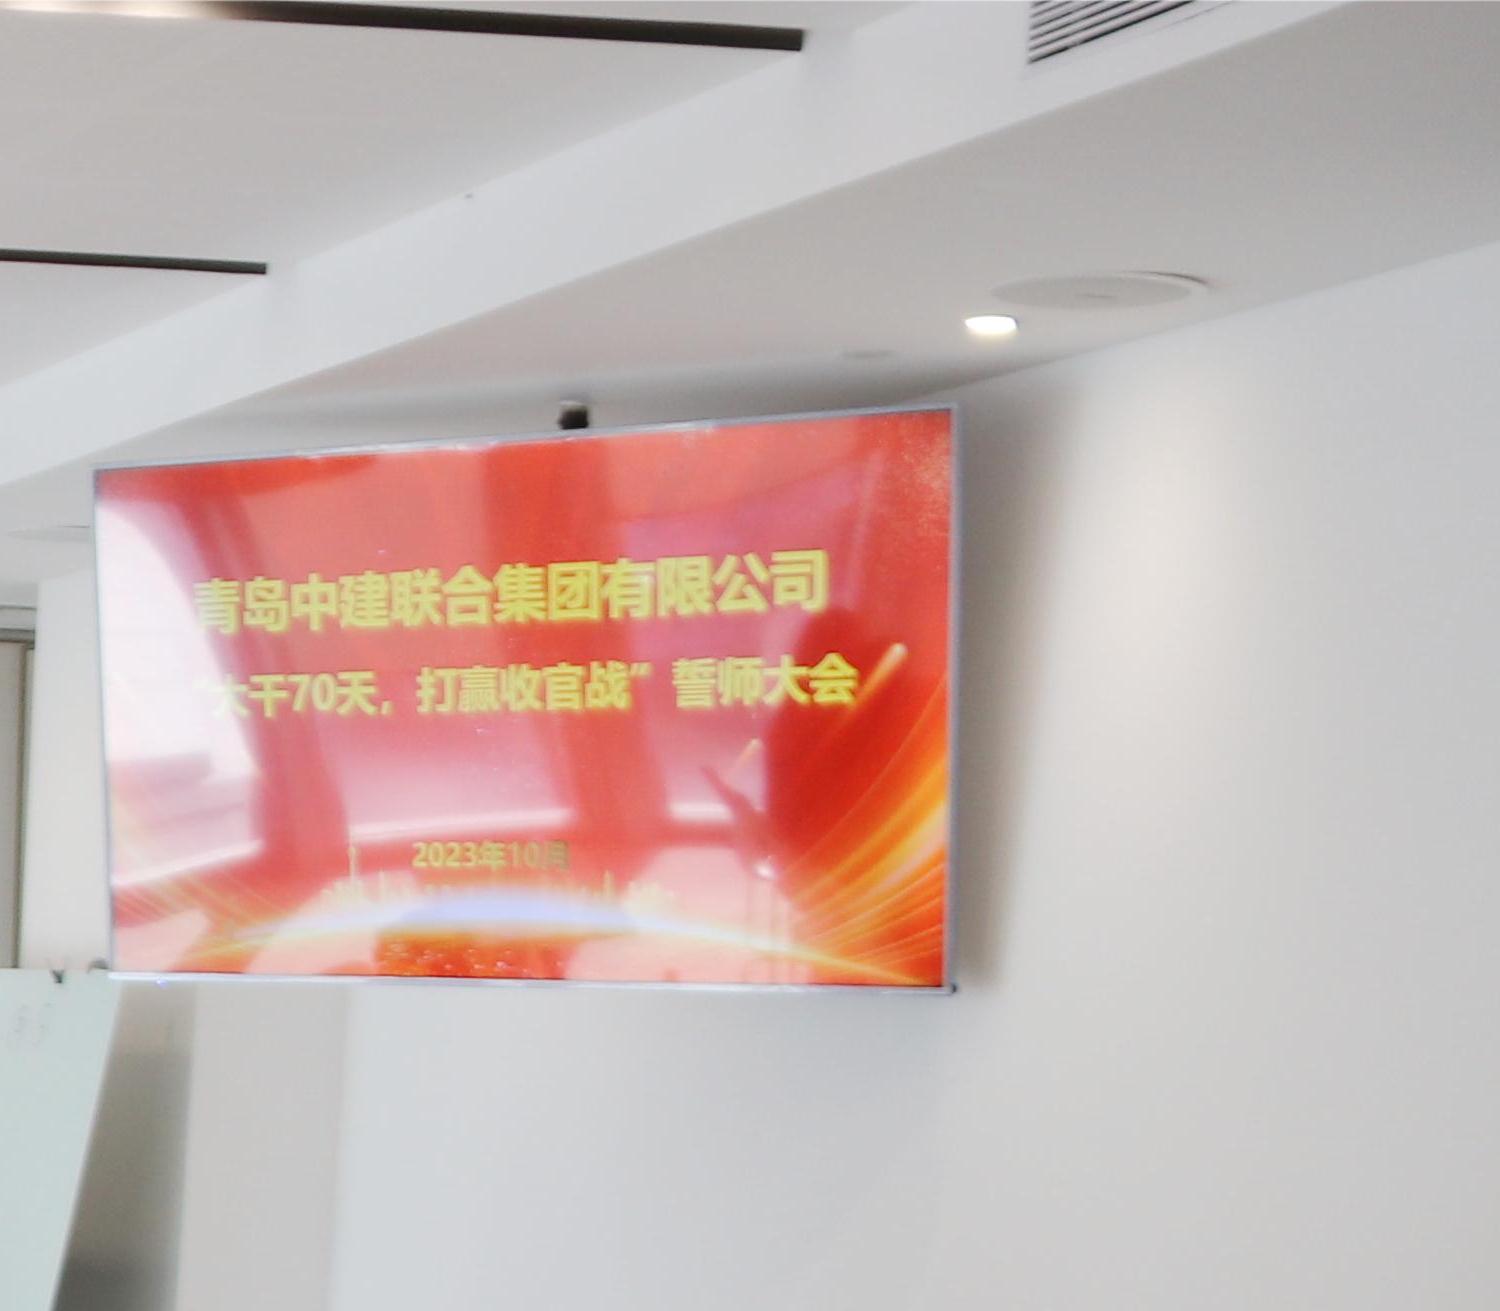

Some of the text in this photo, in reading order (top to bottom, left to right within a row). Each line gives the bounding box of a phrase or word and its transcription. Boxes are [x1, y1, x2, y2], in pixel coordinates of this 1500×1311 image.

[194, 548, 830, 637] 青岛中建联合集团有限公司
[411, 838, 569, 870] 2023年10月
